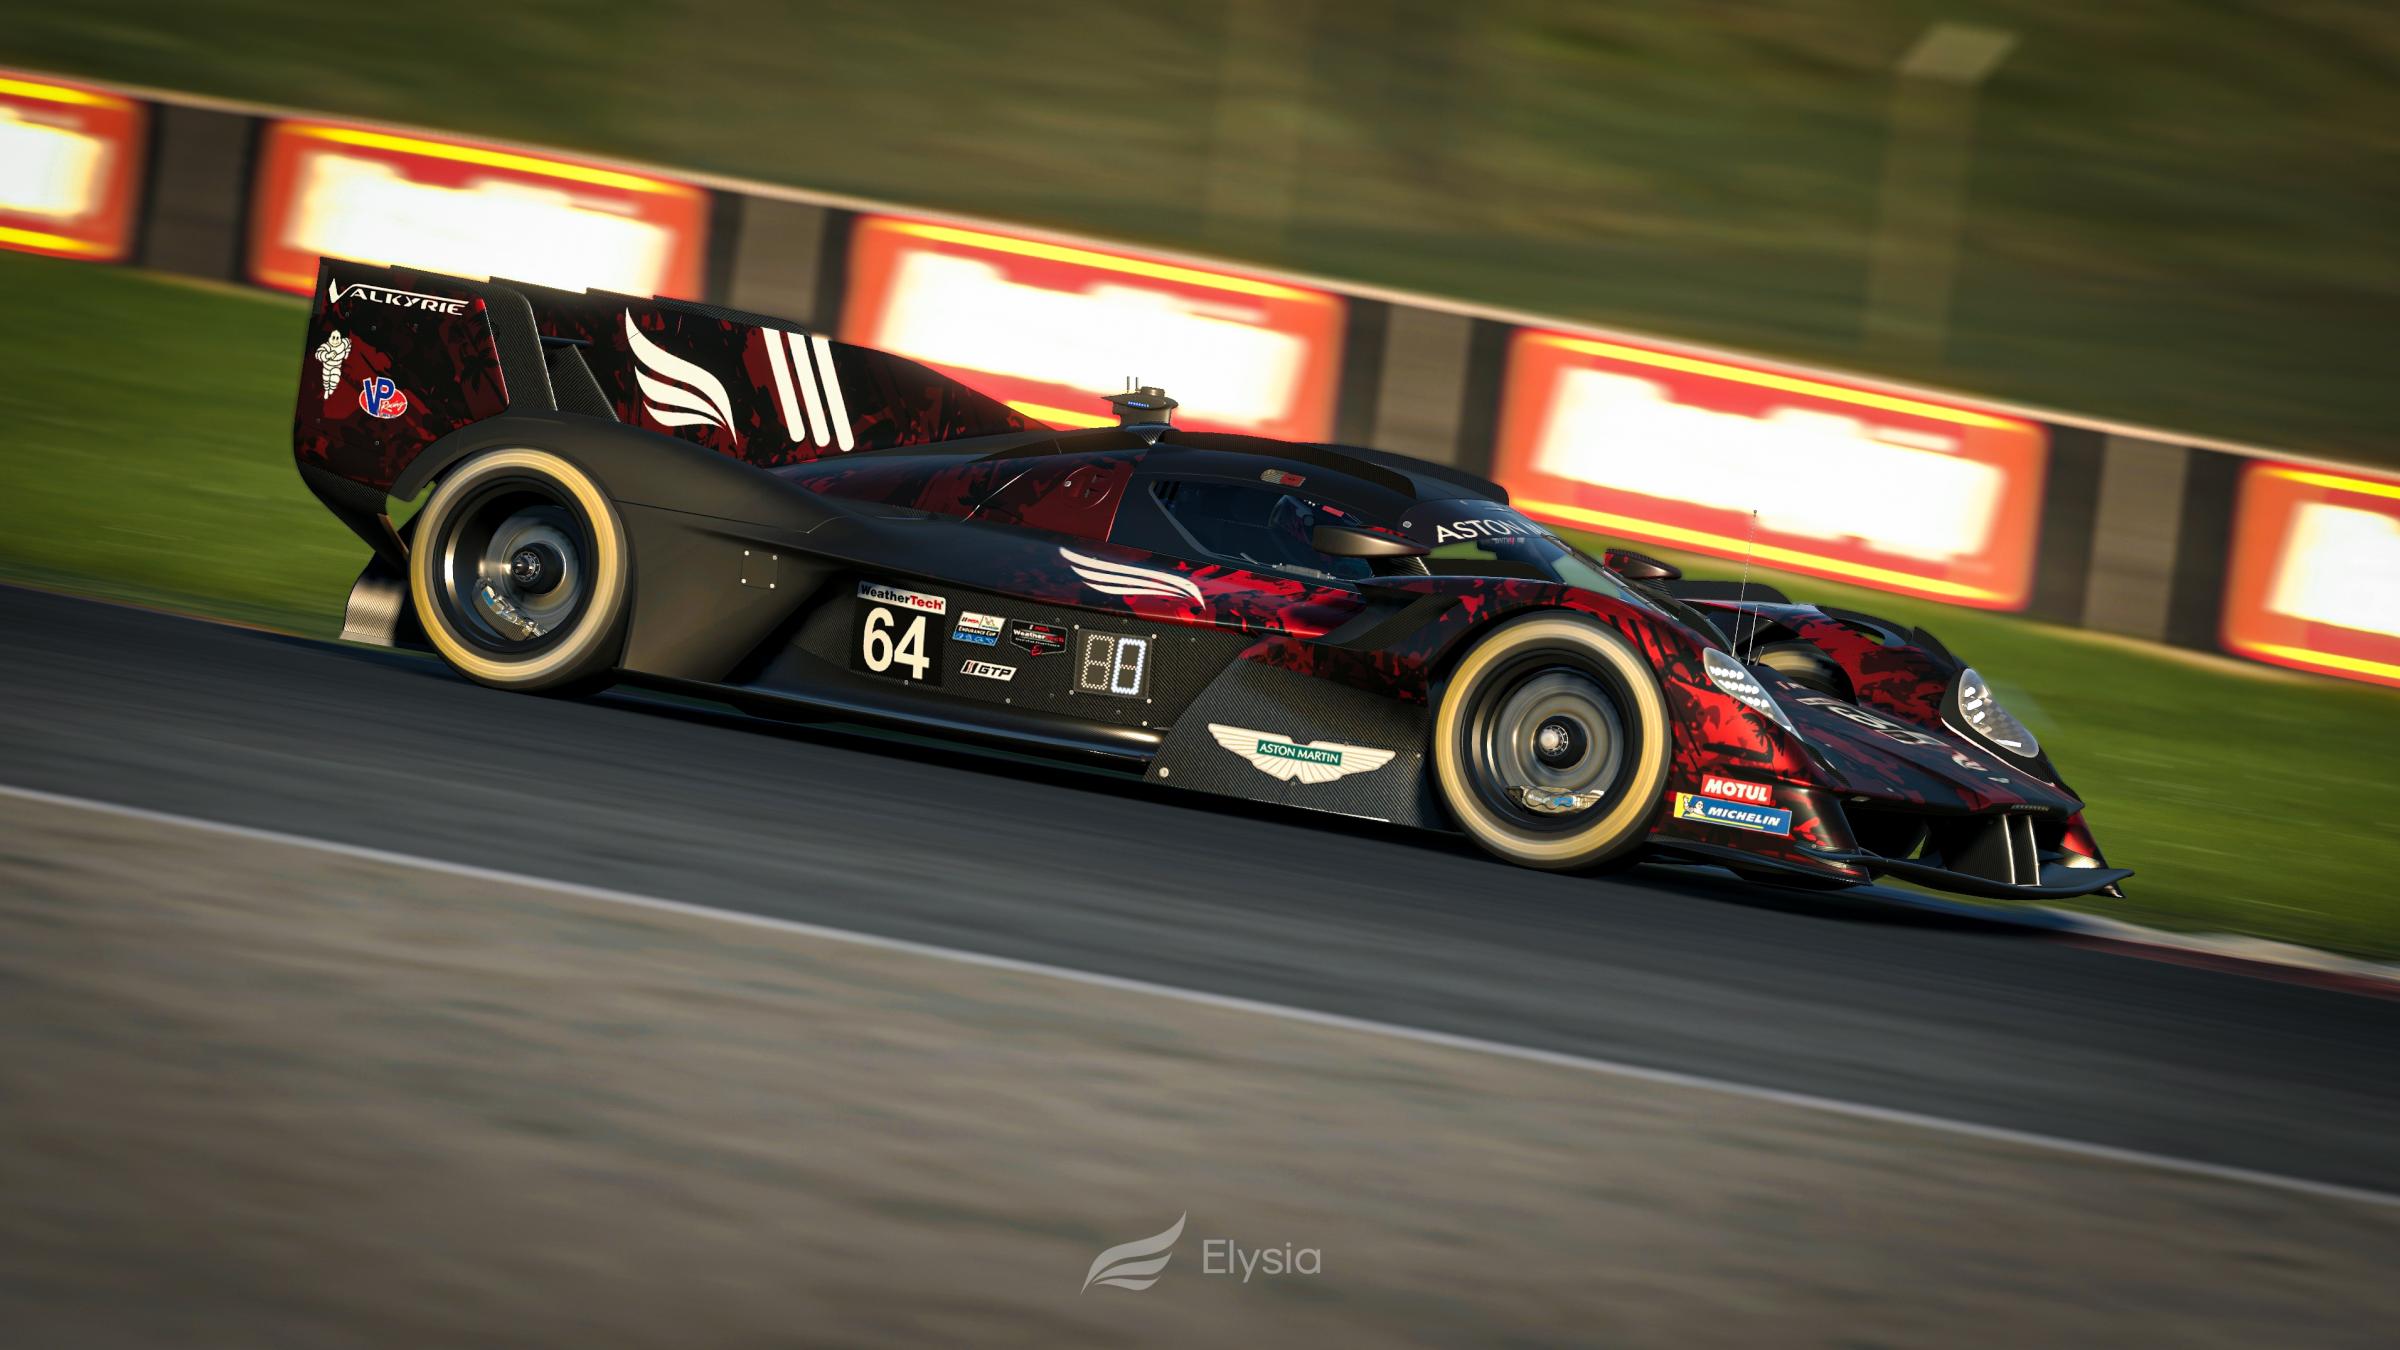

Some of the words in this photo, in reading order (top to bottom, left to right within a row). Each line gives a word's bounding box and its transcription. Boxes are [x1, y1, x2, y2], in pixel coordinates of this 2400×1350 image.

[328, 278, 469, 316] VALKYRIE
[362, 376, 395, 417] VP
[1436, 519, 1530, 544] ASTON
[860, 584, 943, 610] WeatherTech
[862, 606, 930, 680] 64
[977, 664, 1012, 677] GTP
[1259, 743, 1296, 757] ASTON
[1297, 749, 1339, 763] MARTIN
[1704, 778, 1768, 802] MOTUL
[1707, 806, 1781, 827] MICHELIN
